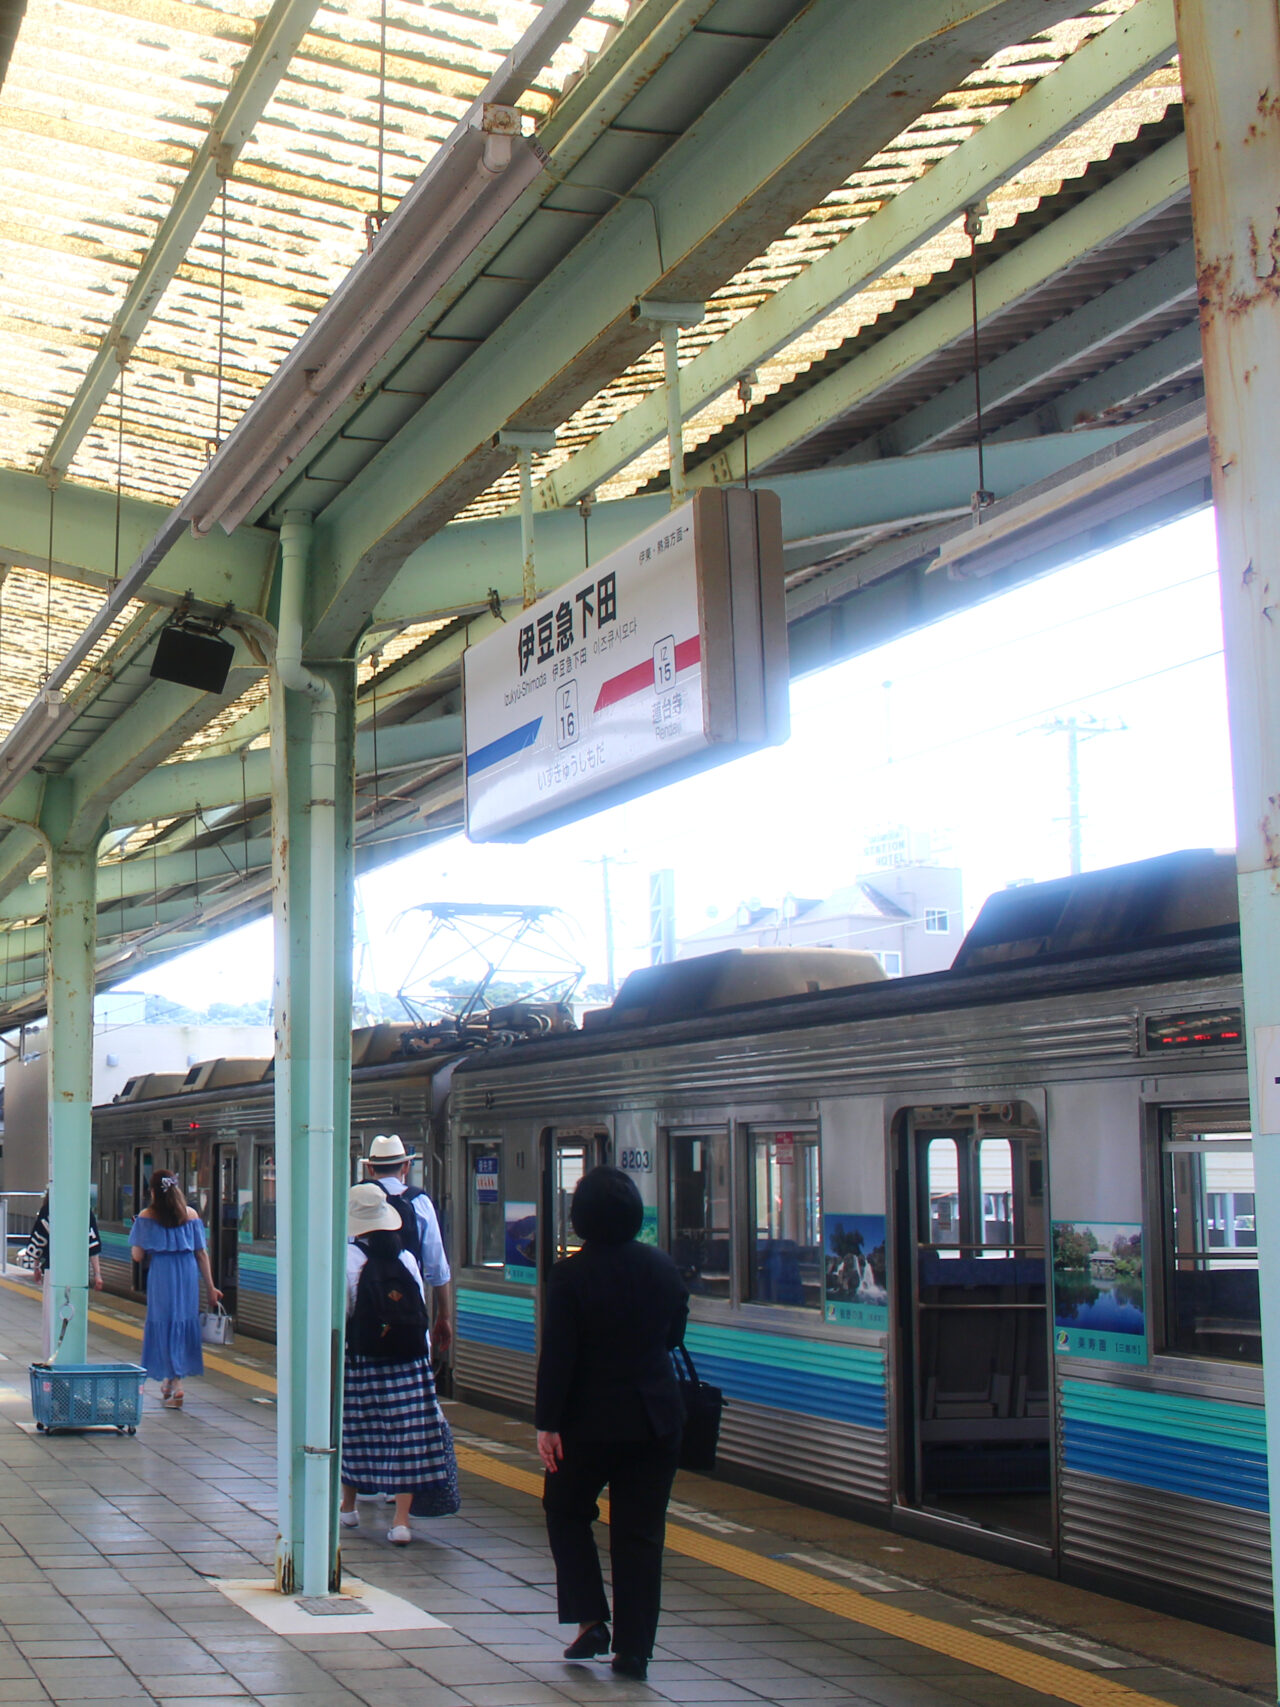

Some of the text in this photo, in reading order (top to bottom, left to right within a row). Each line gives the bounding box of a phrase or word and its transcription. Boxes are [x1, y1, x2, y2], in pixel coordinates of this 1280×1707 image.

[518, 571, 616, 676] 伊豆急下田
[659, 663, 671, 684] 15
[560, 712, 575, 740] 16
[622, 1151, 650, 1168] 8203
